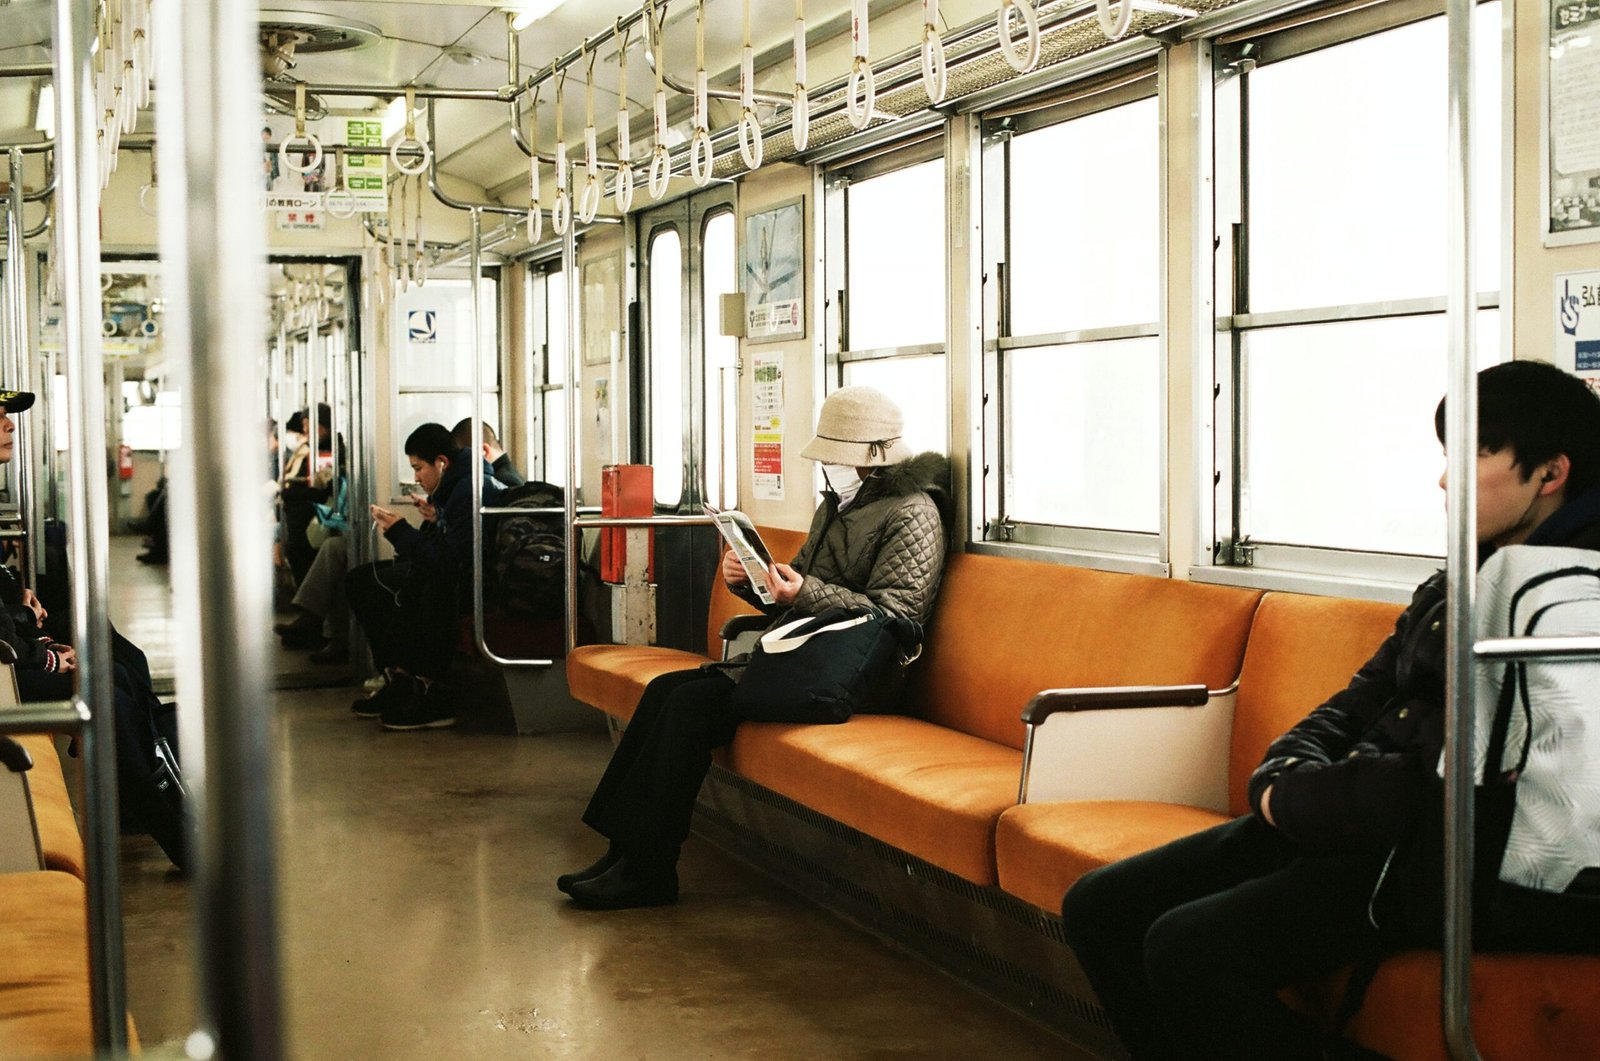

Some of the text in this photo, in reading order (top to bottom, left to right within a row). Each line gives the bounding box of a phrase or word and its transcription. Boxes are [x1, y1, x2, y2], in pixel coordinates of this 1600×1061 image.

[1560, 2, 1600, 25] セミナー
[266, 198, 317, 207] の教育ローン
[1582, 285, 1600, 308] 弘
